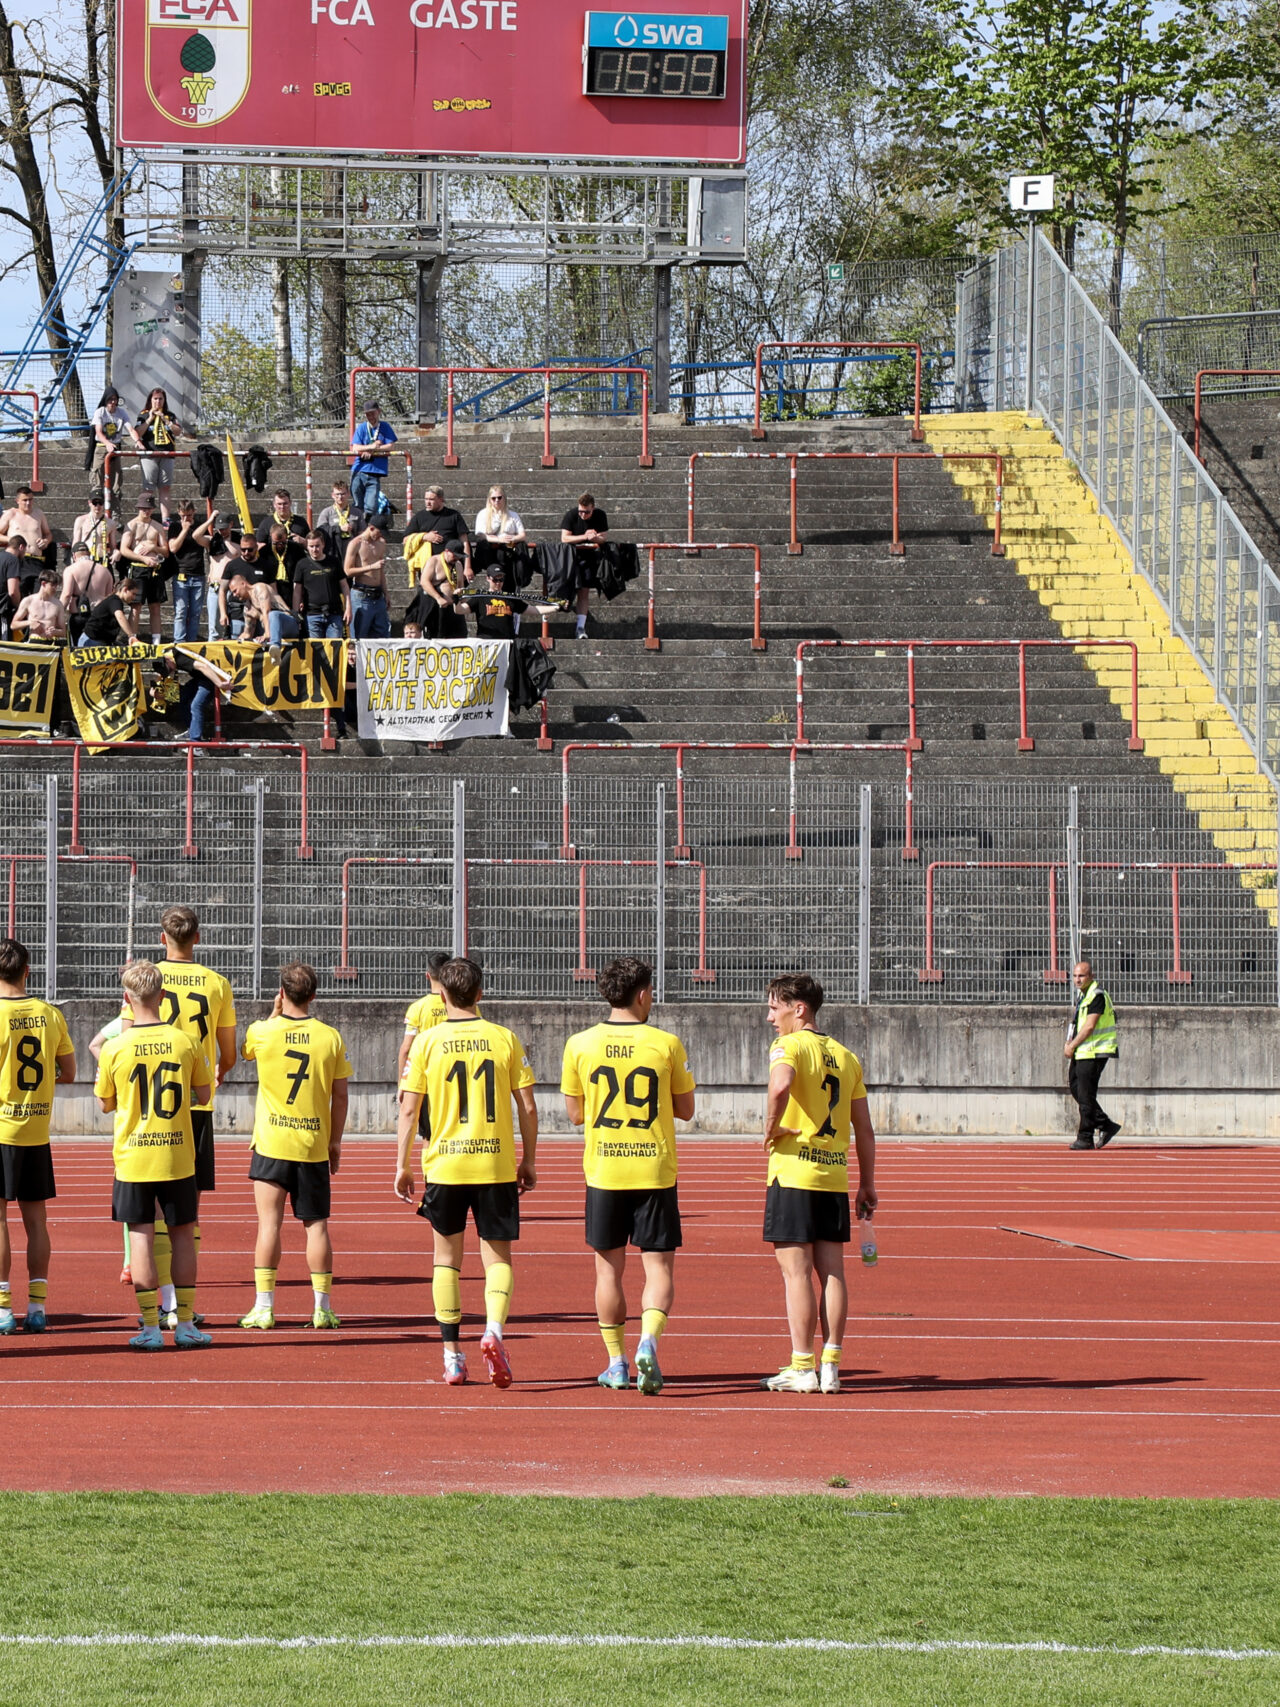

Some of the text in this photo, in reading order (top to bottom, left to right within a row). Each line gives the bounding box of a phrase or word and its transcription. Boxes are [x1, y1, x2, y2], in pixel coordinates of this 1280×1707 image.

[311, 0, 375, 26] FCA
[642, 23, 703, 46] swa
[181, 105, 213, 119] 1907
[1023, 181, 1041, 205] F
[72, 644, 158, 669] SUPCREW
[365, 645, 499, 679] LOVE FOOTBALL
[368, 675, 497, 711] HATE RACISM
[439, 713, 461, 724] GEGEN
[163, 973, 207, 987] CHUBERT
[9, 1015, 47, 1030] SCHEDER
[285, 1032, 310, 1045] HEIM
[134, 1042, 172, 1057] ZIETSCH
[442, 1039, 492, 1055] STEFANDL
[605, 1045, 635, 1059] GRAF
[16, 1035, 44, 1091] 8
[284, 1049, 310, 1105] 7
[129, 1060, 183, 1121] 16
[446, 1058, 496, 1124] 11
[590, 1065, 659, 1130] 29
[815, 1073, 840, 1138] 2
[278, 1120, 320, 1130] BRAUHAUS
[137, 1130, 183, 1139] BAYREUTHER
[137, 1138, 183, 1147] BRAUHAUS
[449, 1146, 501, 1154] BRAUHAUS
[450, 1138, 500, 1147] BAYREUTHER
[603, 1142, 657, 1150] BAYREUTHER
[603, 1149, 657, 1158] BRAUHAUS
